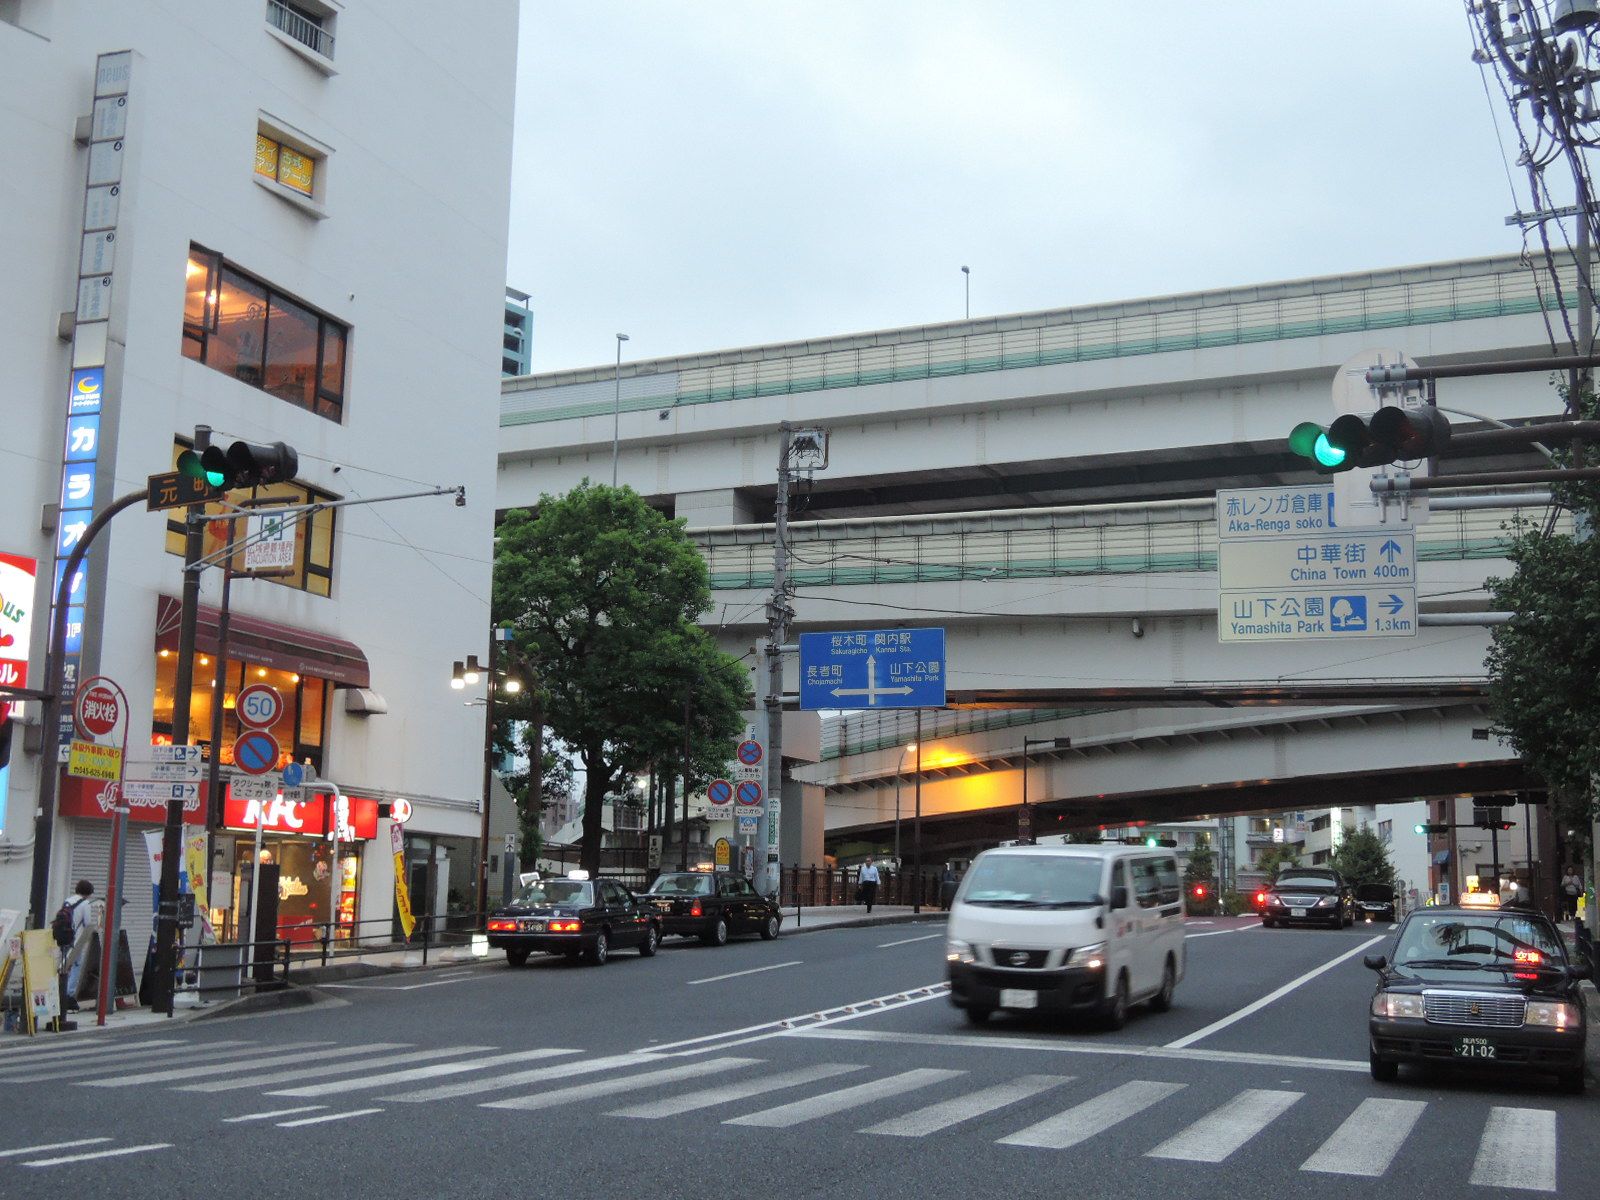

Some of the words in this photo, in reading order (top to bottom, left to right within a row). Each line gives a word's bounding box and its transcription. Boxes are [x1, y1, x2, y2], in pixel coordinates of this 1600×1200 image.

[1227, 492, 1322, 516] 赤レンガ倉庫
[1229, 518, 1290, 532] Aka-Renga
[1296, 516, 1323, 529] soko
[1297, 543, 1366, 565] 中華街
[1290, 568, 1327, 581] China
[1333, 566, 1367, 579] Town
[1373, 564, 1410, 577] 400m
[1233, 597, 1324, 618] 山下公園
[1231, 621, 1292, 634] Yamashita
[1297, 620, 1325, 632] Park
[1375, 618, 1411, 631] 1.3km
[831, 634, 867, 647] 桜木町
[874, 632, 912, 645] 関内駅
[831, 648, 868, 656] Sakuragicho
[807, 664, 842, 678] 長者町
[890, 661, 940, 675] 山下公園
[807, 678, 843, 686] Chojamachi
[83, 700, 117, 723] 消火栓
[246, 696, 273, 716] 50
[233, 789, 274, 798] ここから
[242, 794, 306, 828] KFC
